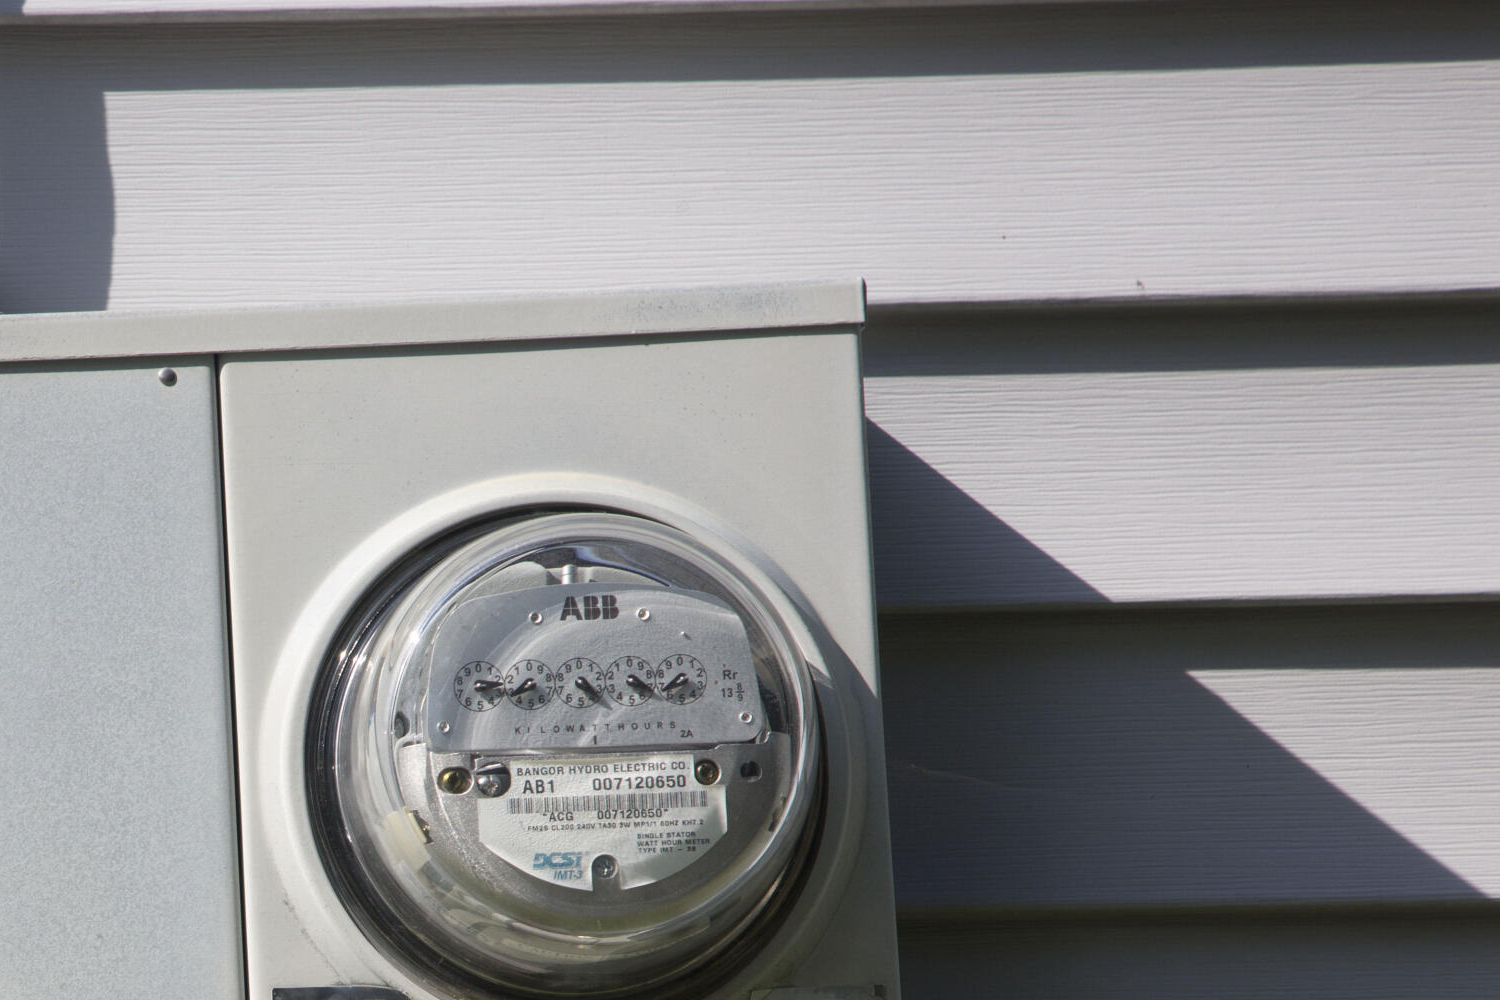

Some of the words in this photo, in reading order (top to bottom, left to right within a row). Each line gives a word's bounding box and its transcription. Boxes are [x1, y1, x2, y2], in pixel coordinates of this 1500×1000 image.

[560, 595, 619, 621] ABB
[517, 766, 564, 776] BANGOR
[569, 766, 608, 774] HYDRO
[614, 763, 666, 773] ELECTRIC
[671, 762, 690, 770] CO.
[523, 780, 554, 794] AB1
[593, 775, 686, 790] 007120650
